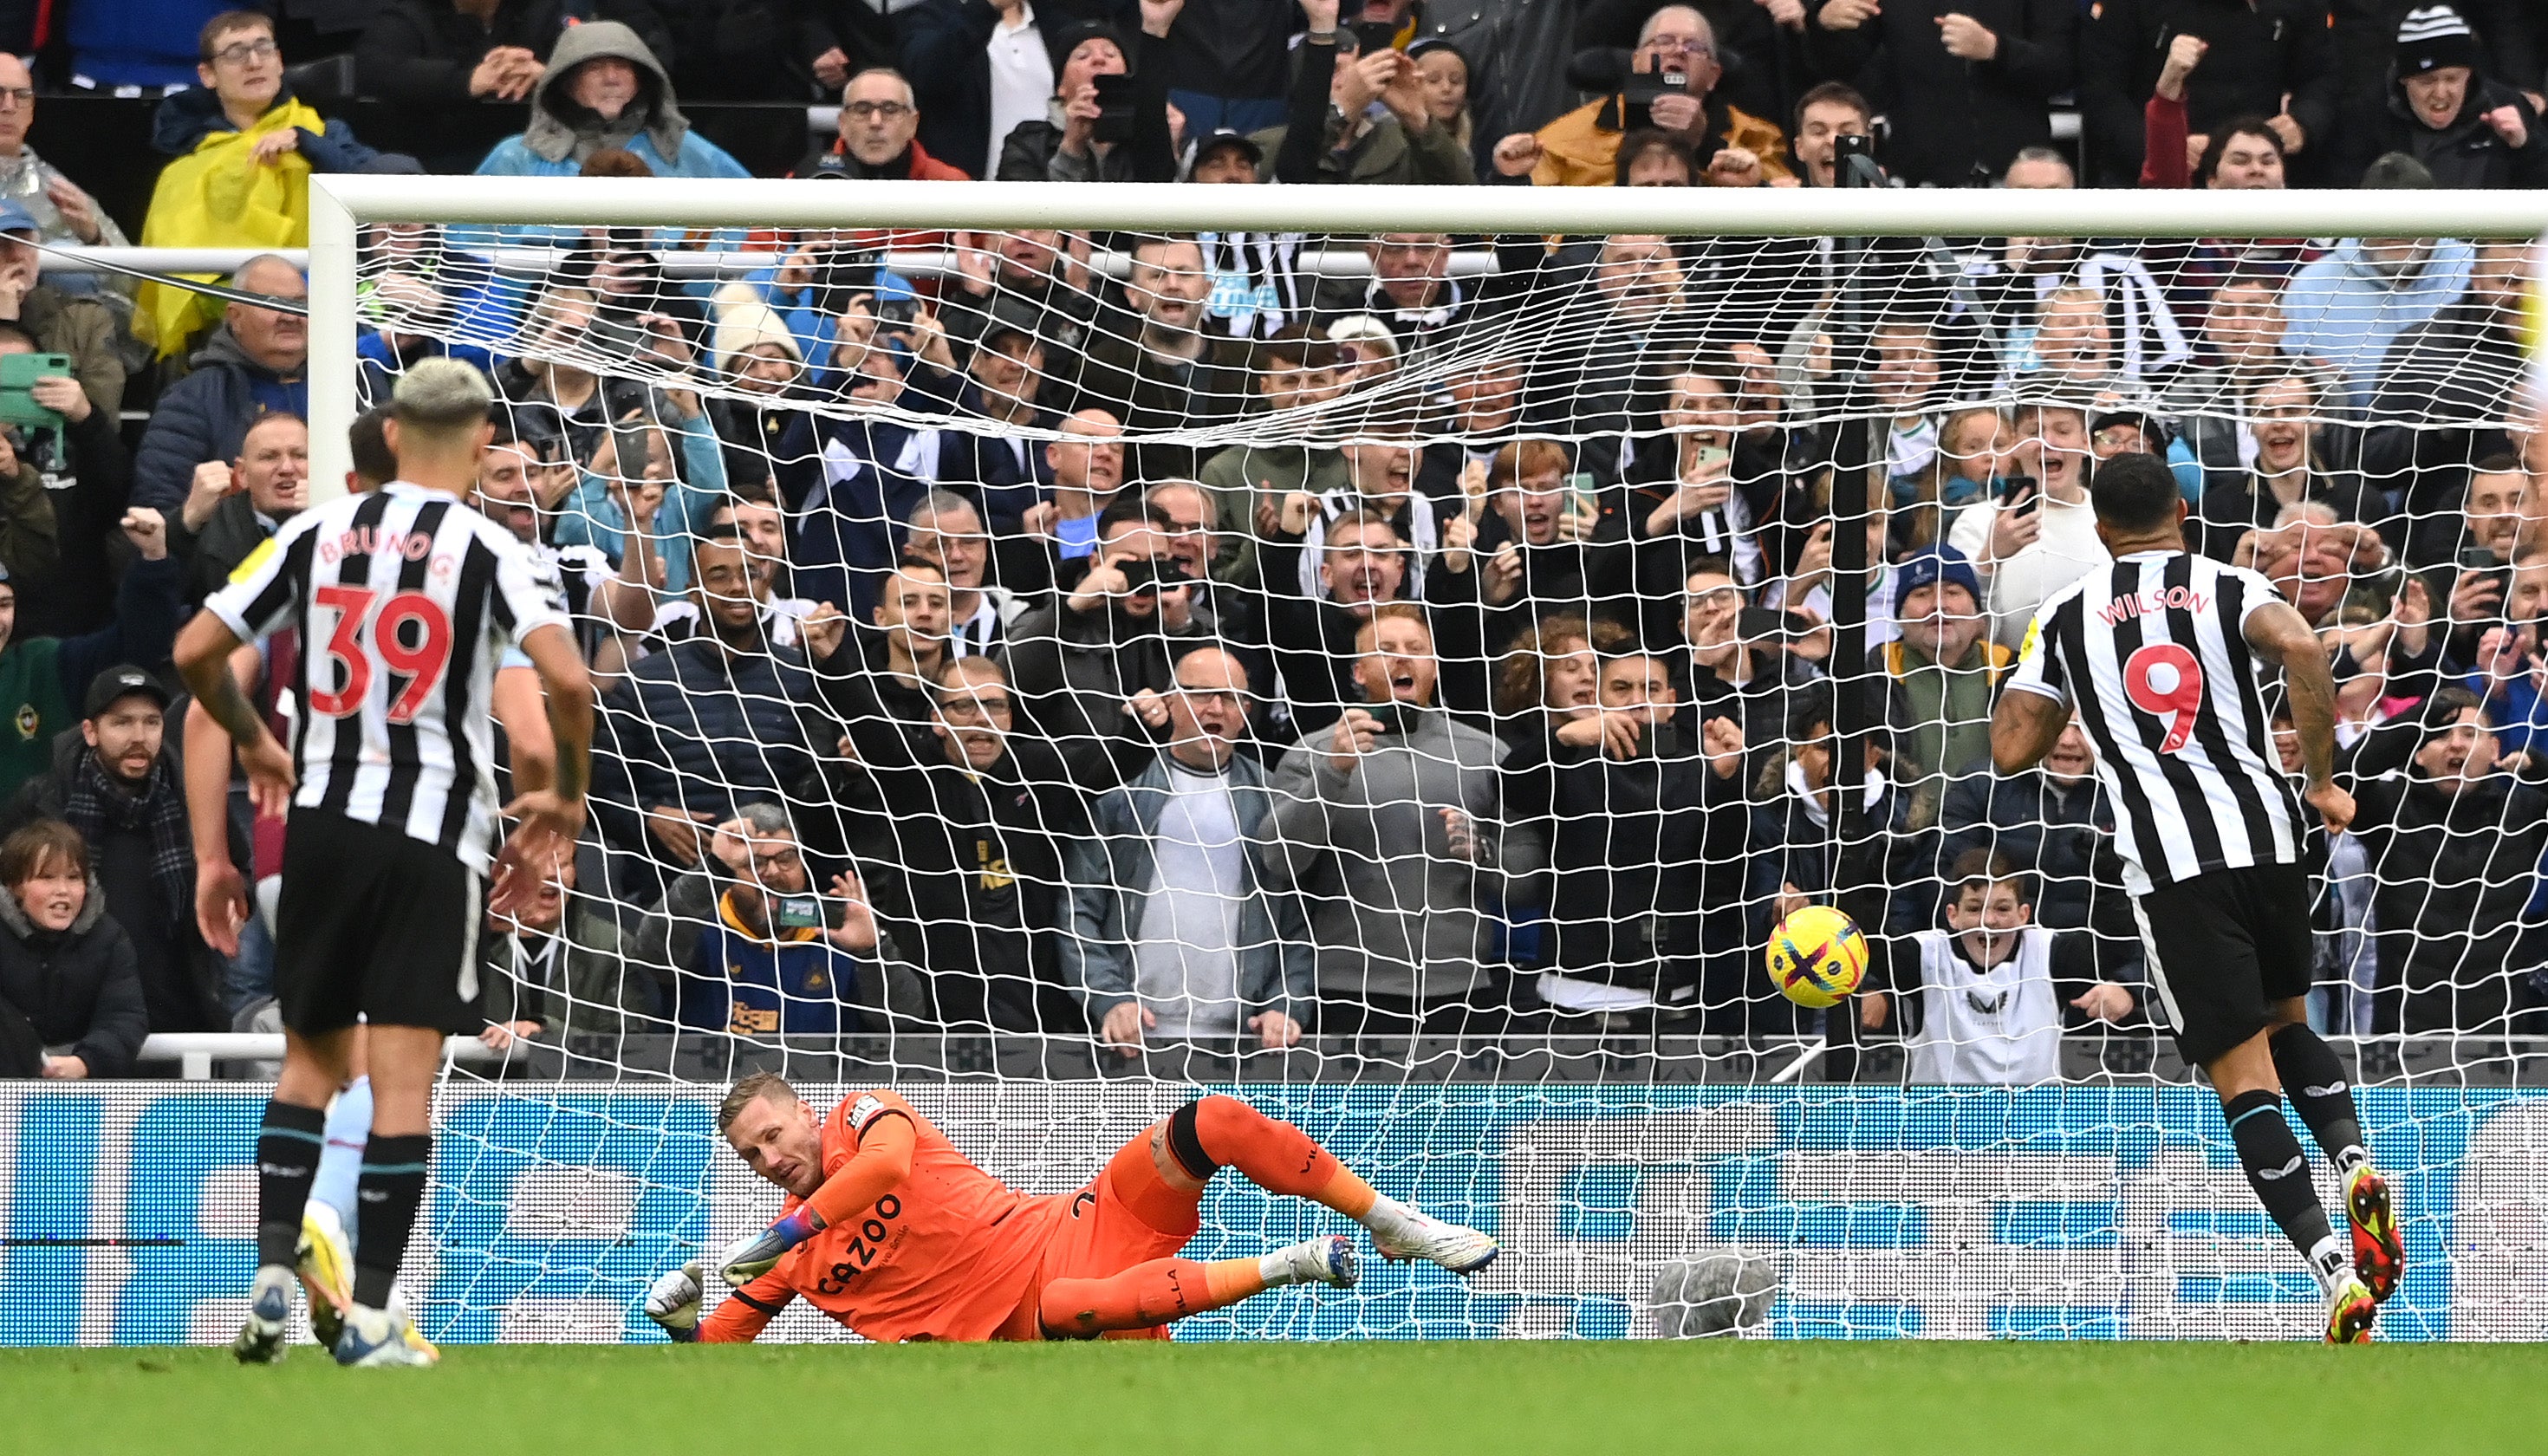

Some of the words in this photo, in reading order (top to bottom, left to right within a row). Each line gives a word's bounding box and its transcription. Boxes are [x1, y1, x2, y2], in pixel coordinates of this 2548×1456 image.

[321, 524, 432, 564] BRUNO
[2096, 585, 2210, 627] WILSON
[309, 585, 455, 725] 39
[2122, 642, 2204, 755] 9
[817, 1193, 901, 1295] CAZOO
[1167, 1268, 1188, 1316] ILLA
